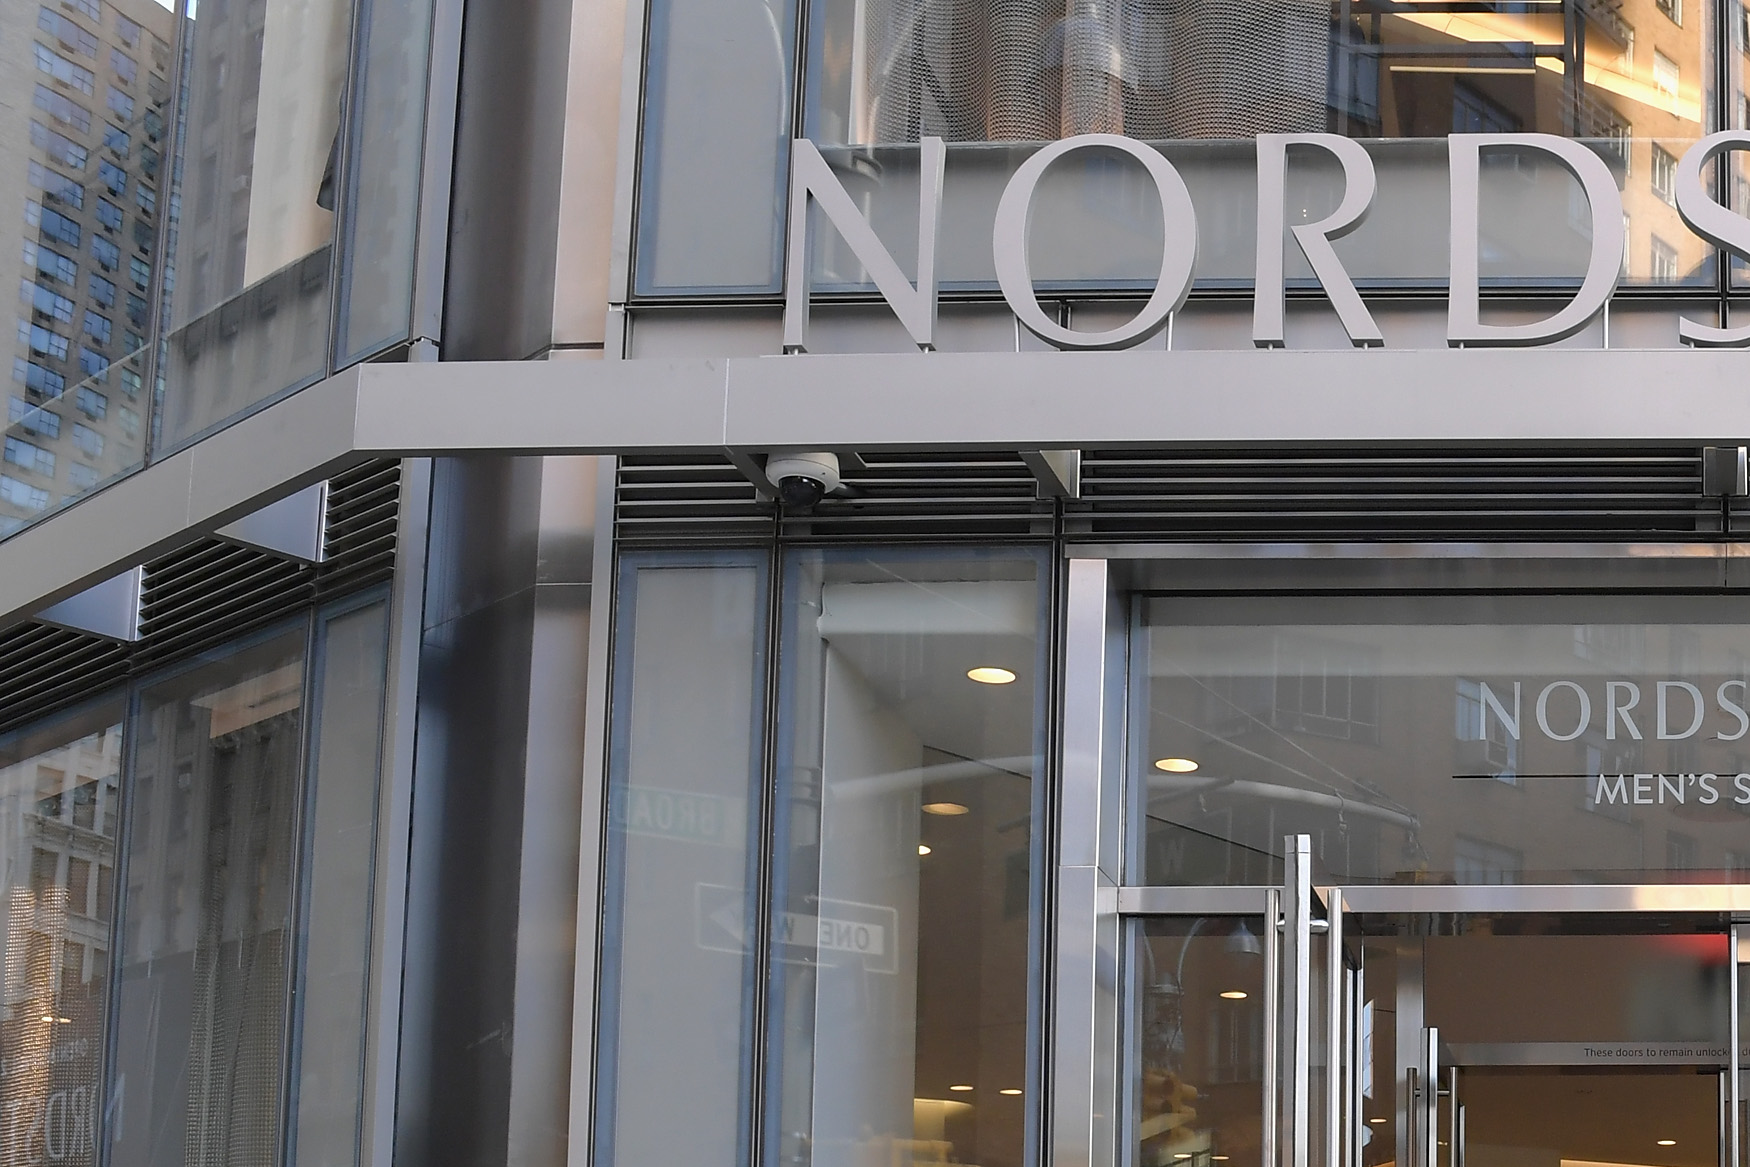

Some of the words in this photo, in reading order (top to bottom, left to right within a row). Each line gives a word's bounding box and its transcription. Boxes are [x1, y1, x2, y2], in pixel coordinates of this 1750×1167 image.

[1594, 773, 1720, 805] MEN'S
[1584, 1047, 1613, 1057] These
[1615, 1047, 1644, 1057] doors
[1646, 1048, 1657, 1057] to
[1659, 1047, 1694, 1057] remain
